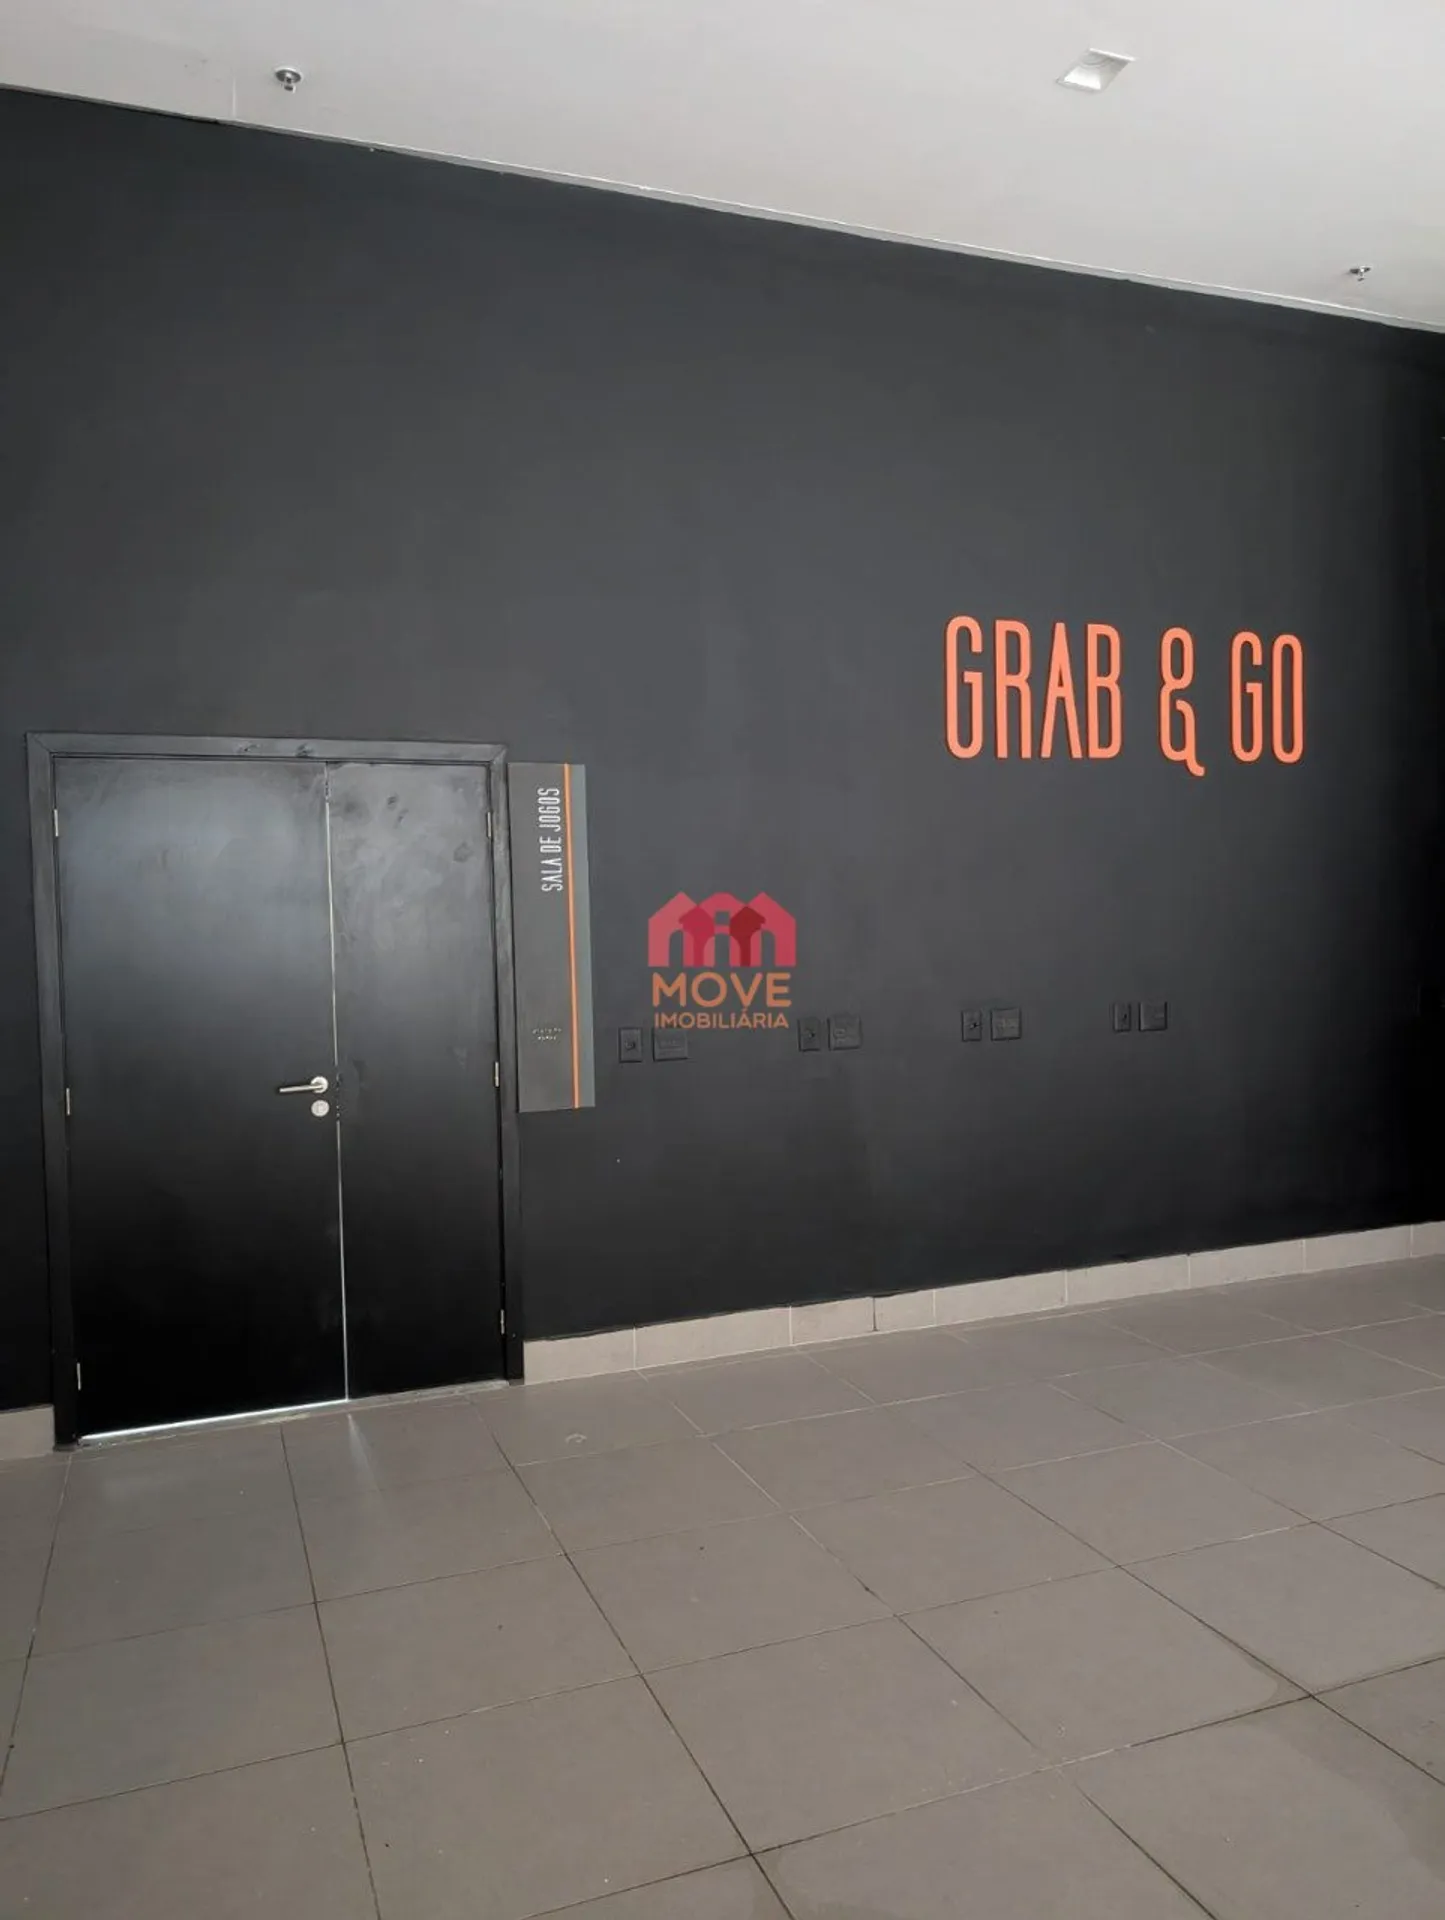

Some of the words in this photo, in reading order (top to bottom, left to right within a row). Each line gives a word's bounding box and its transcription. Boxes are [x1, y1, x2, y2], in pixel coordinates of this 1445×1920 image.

[945, 615, 1122, 759] GRAB
[1160, 627, 1206, 777] &
[1231, 631, 1304, 763] GO
[537, 787, 561, 832] JOGOS
[539, 836, 562, 853] DE
[540, 858, 564, 892] SALA
